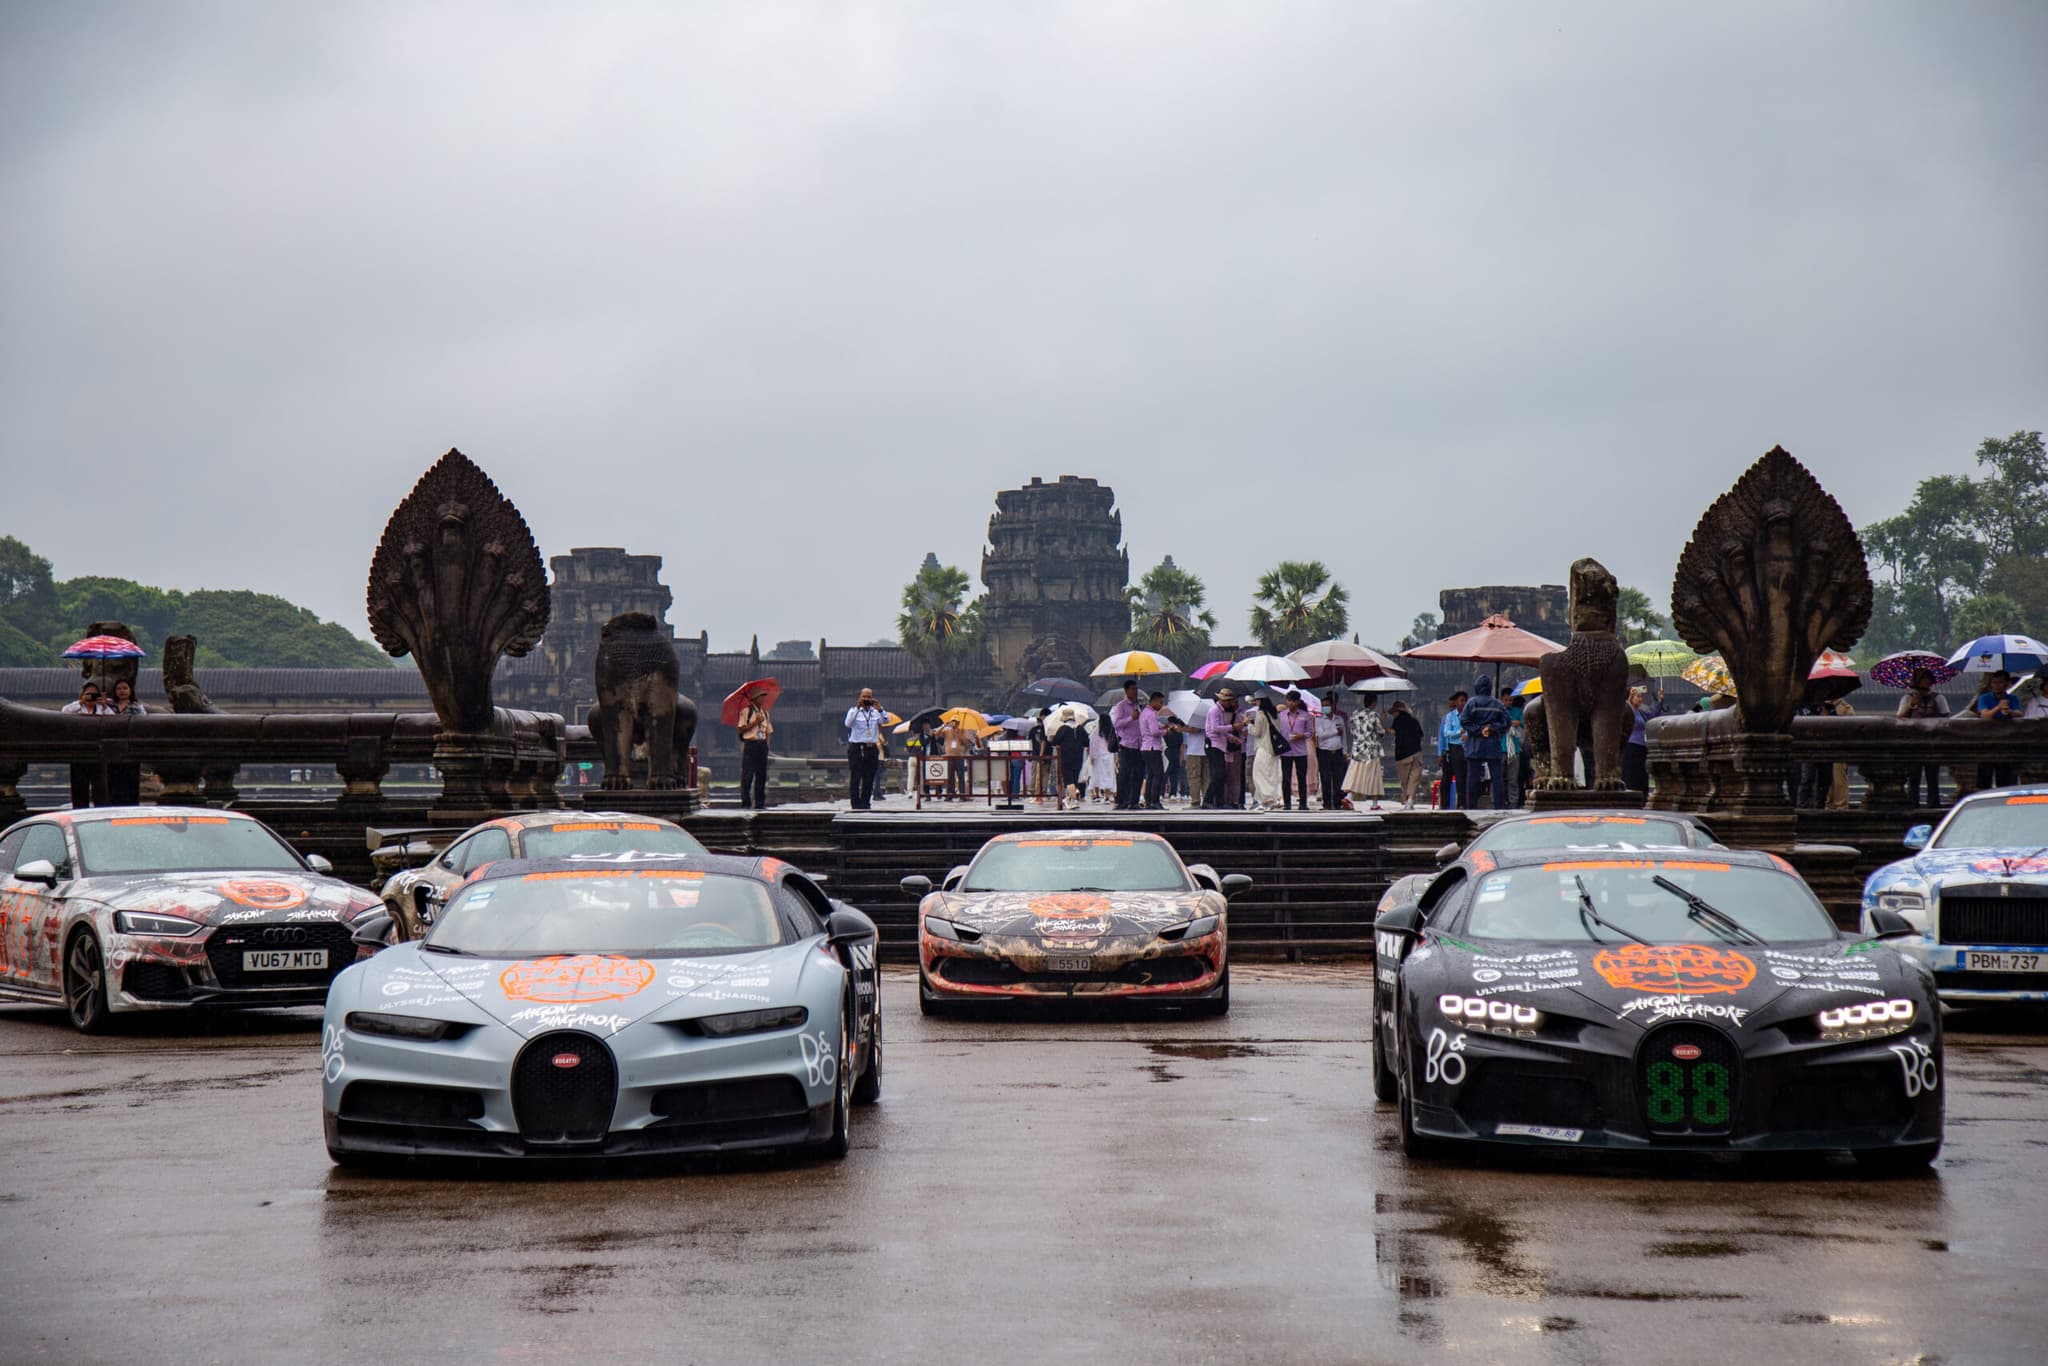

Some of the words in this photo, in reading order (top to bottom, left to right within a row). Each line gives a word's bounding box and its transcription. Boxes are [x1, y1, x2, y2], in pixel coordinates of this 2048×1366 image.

[251, 952, 290, 968] VU67
[294, 952, 322, 967] MTO
[1058, 958, 1089, 970] 5510
[1970, 953, 2000, 969] PBM
[2011, 955, 2039, 970] 737
[503, 1003, 569, 1028] SAIGON
[1616, 993, 1681, 1020] SAIGON
[1646, 1003, 1750, 1028] SINGAPORE
[528, 1012, 631, 1036] SINGAPORE
[555, 1057, 578, 1065] BUGATTI
[1647, 1062, 1730, 1124] 88
